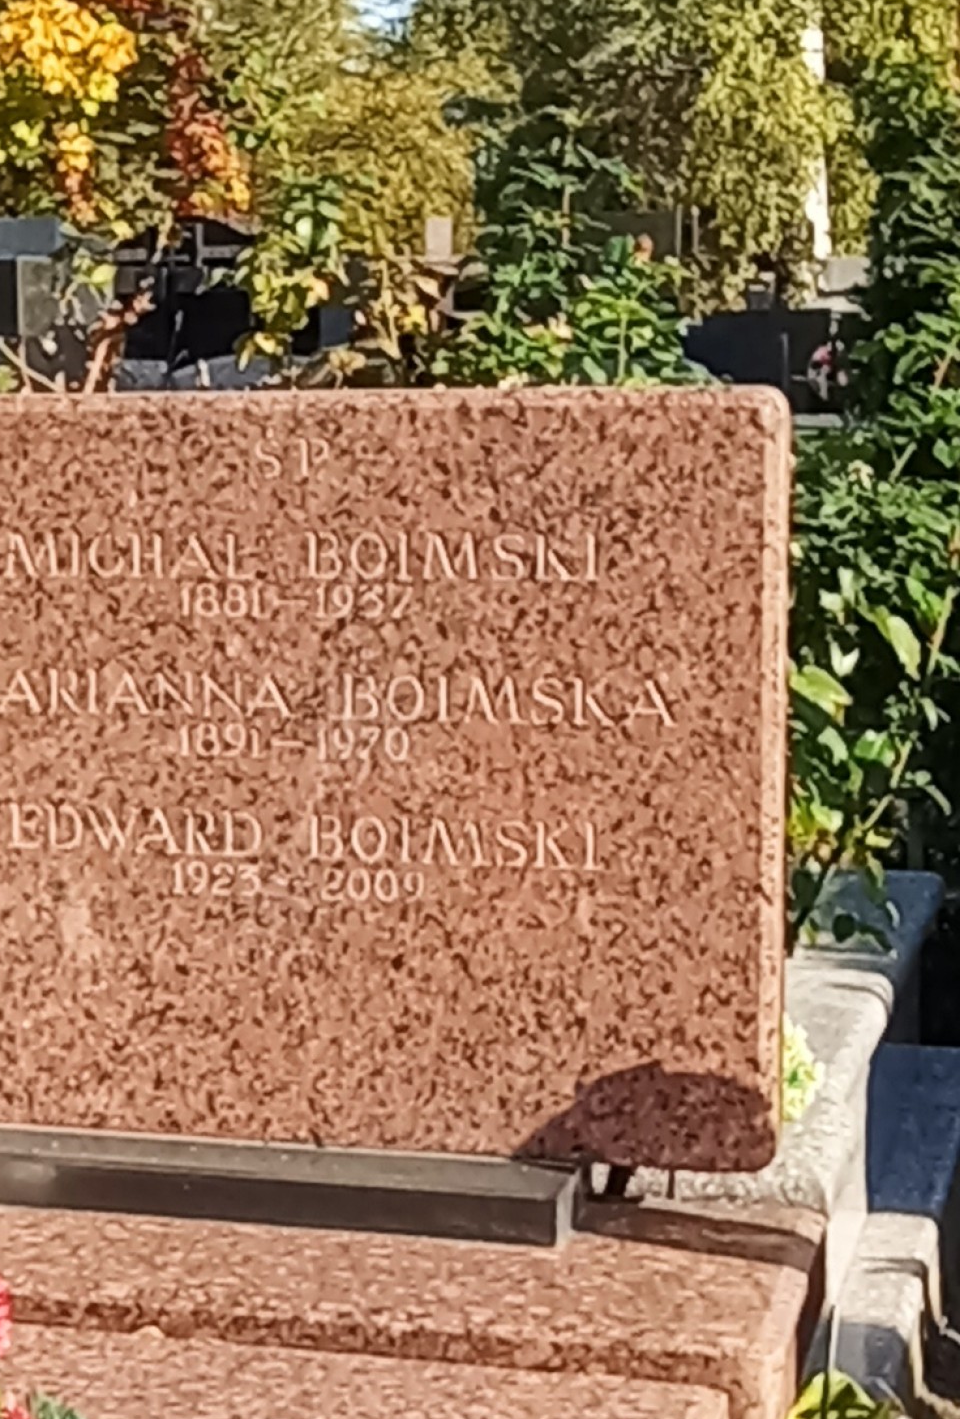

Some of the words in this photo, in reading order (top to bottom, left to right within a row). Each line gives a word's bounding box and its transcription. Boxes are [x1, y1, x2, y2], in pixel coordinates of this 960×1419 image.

[305, 529, 598, 582] BOIMSKI
[340, 674, 677, 729] BOIMSKA
[7, 799, 265, 857] EDWARD
[307, 813, 604, 872] BOIMSKI
